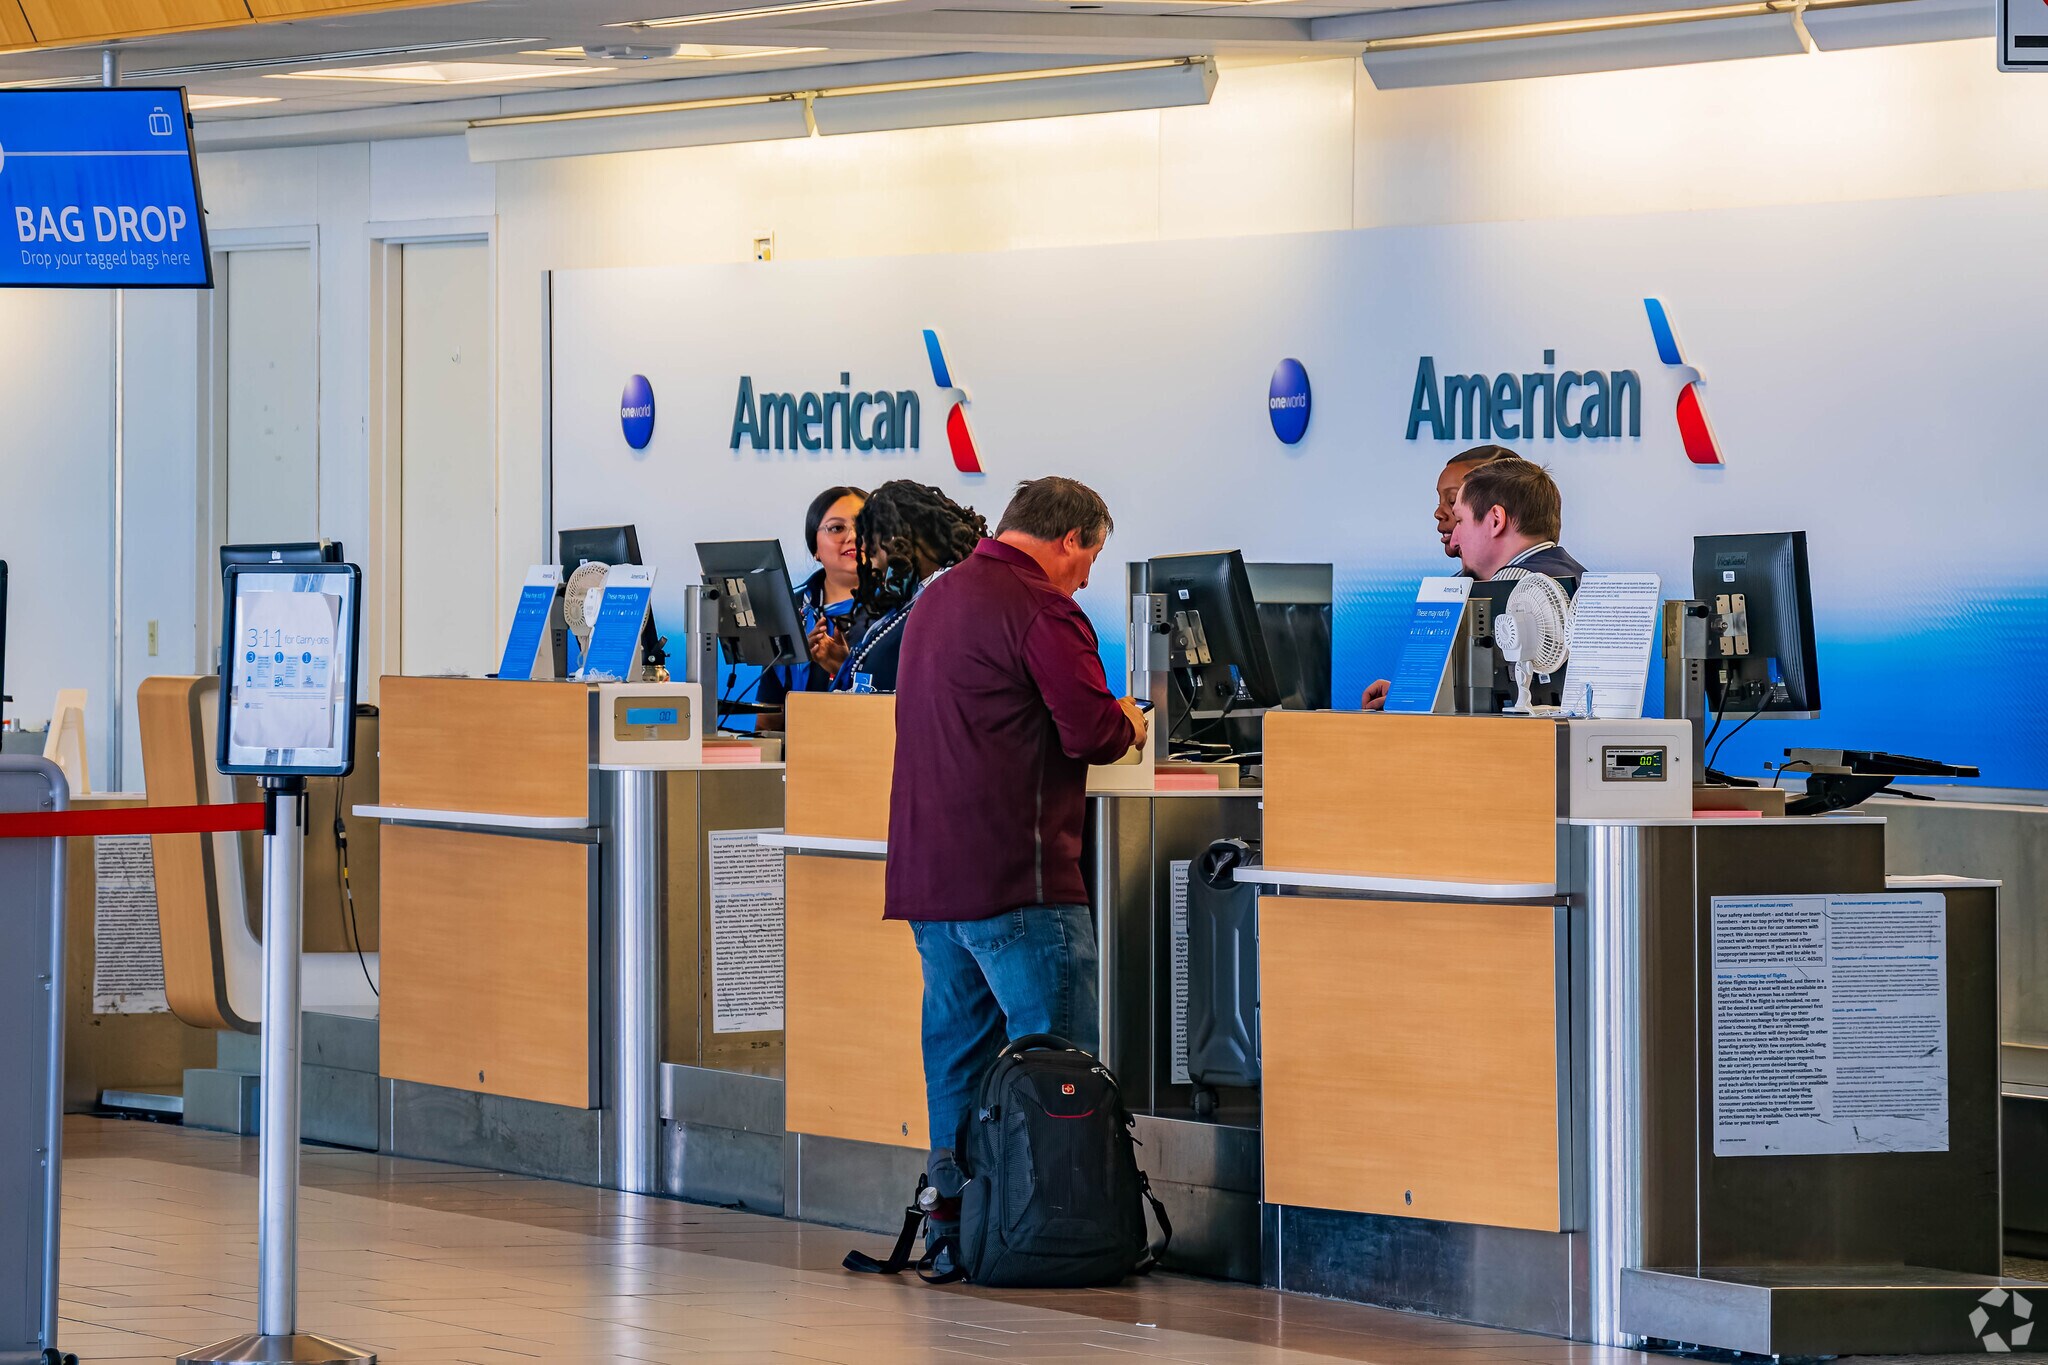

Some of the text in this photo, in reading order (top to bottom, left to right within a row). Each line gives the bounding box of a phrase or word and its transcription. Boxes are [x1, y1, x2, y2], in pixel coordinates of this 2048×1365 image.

[15, 205, 186, 242] BAG DROP
[21, 250, 190, 270] Drop your tagged bags here
[1270, 393, 1305, 409] oneworld
[1406, 350, 1641, 439] American
[622, 404, 651, 418] oneworld
[730, 372, 919, 450] American
[247, 629, 329, 647] 3-1-1 for Carry-ons
[1640, 757, 1652, 765] 0.0
